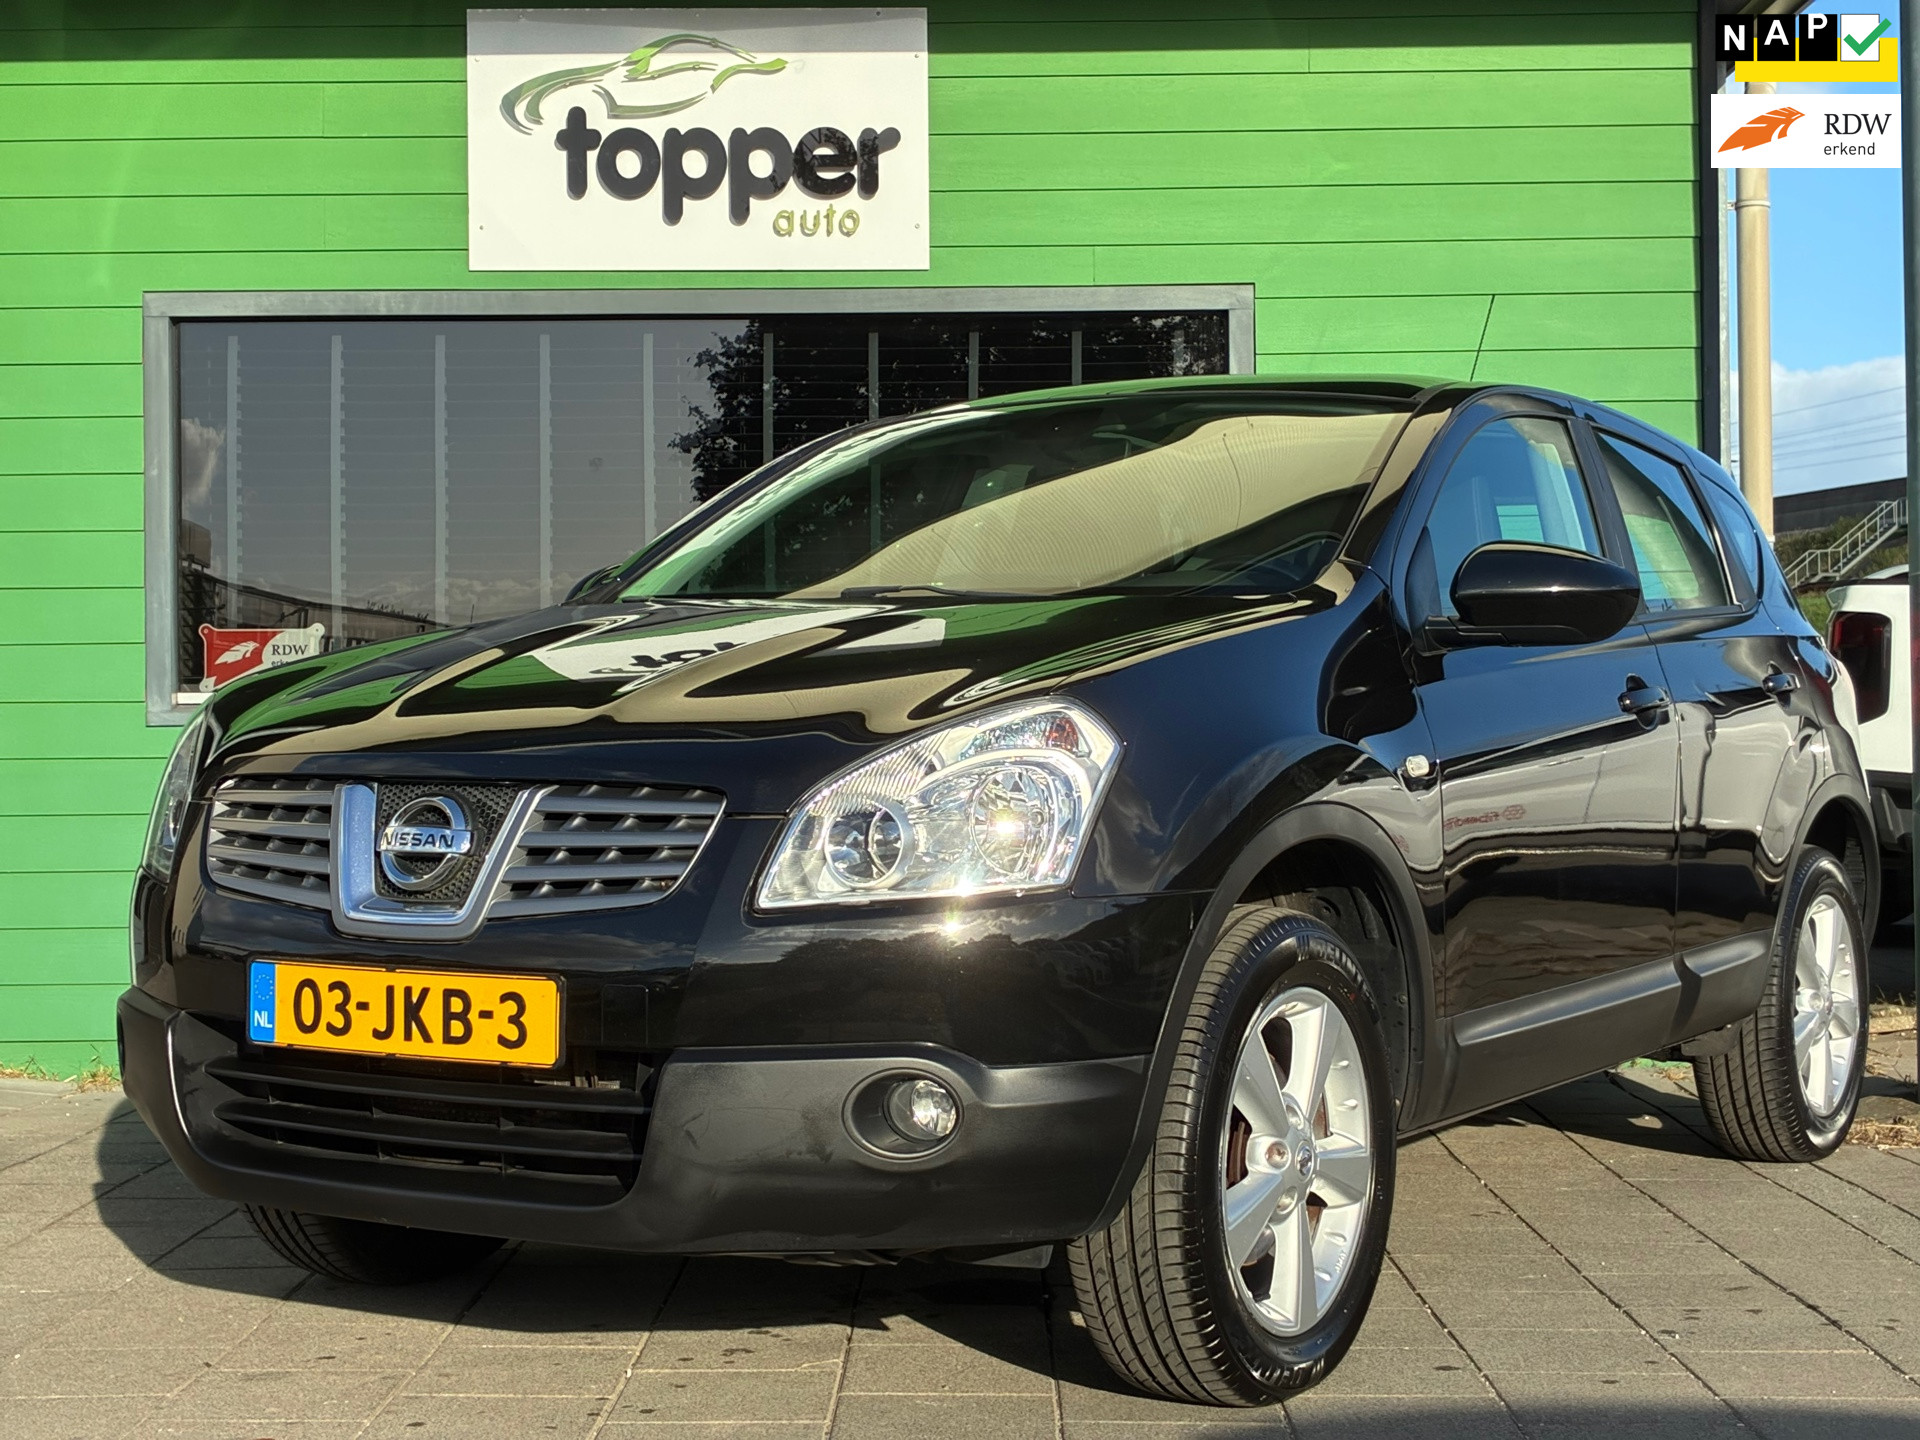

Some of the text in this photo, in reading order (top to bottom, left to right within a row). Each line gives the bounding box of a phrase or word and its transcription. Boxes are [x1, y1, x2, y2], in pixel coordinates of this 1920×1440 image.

[554, 106, 901, 226] topper
[773, 204, 860, 237] auto
[271, 644, 308, 655] RDW
[382, 832, 455, 848] NISSAN
[254, 1010, 273, 1028] NL
[293, 977, 527, 1049] 03-JKB-3
